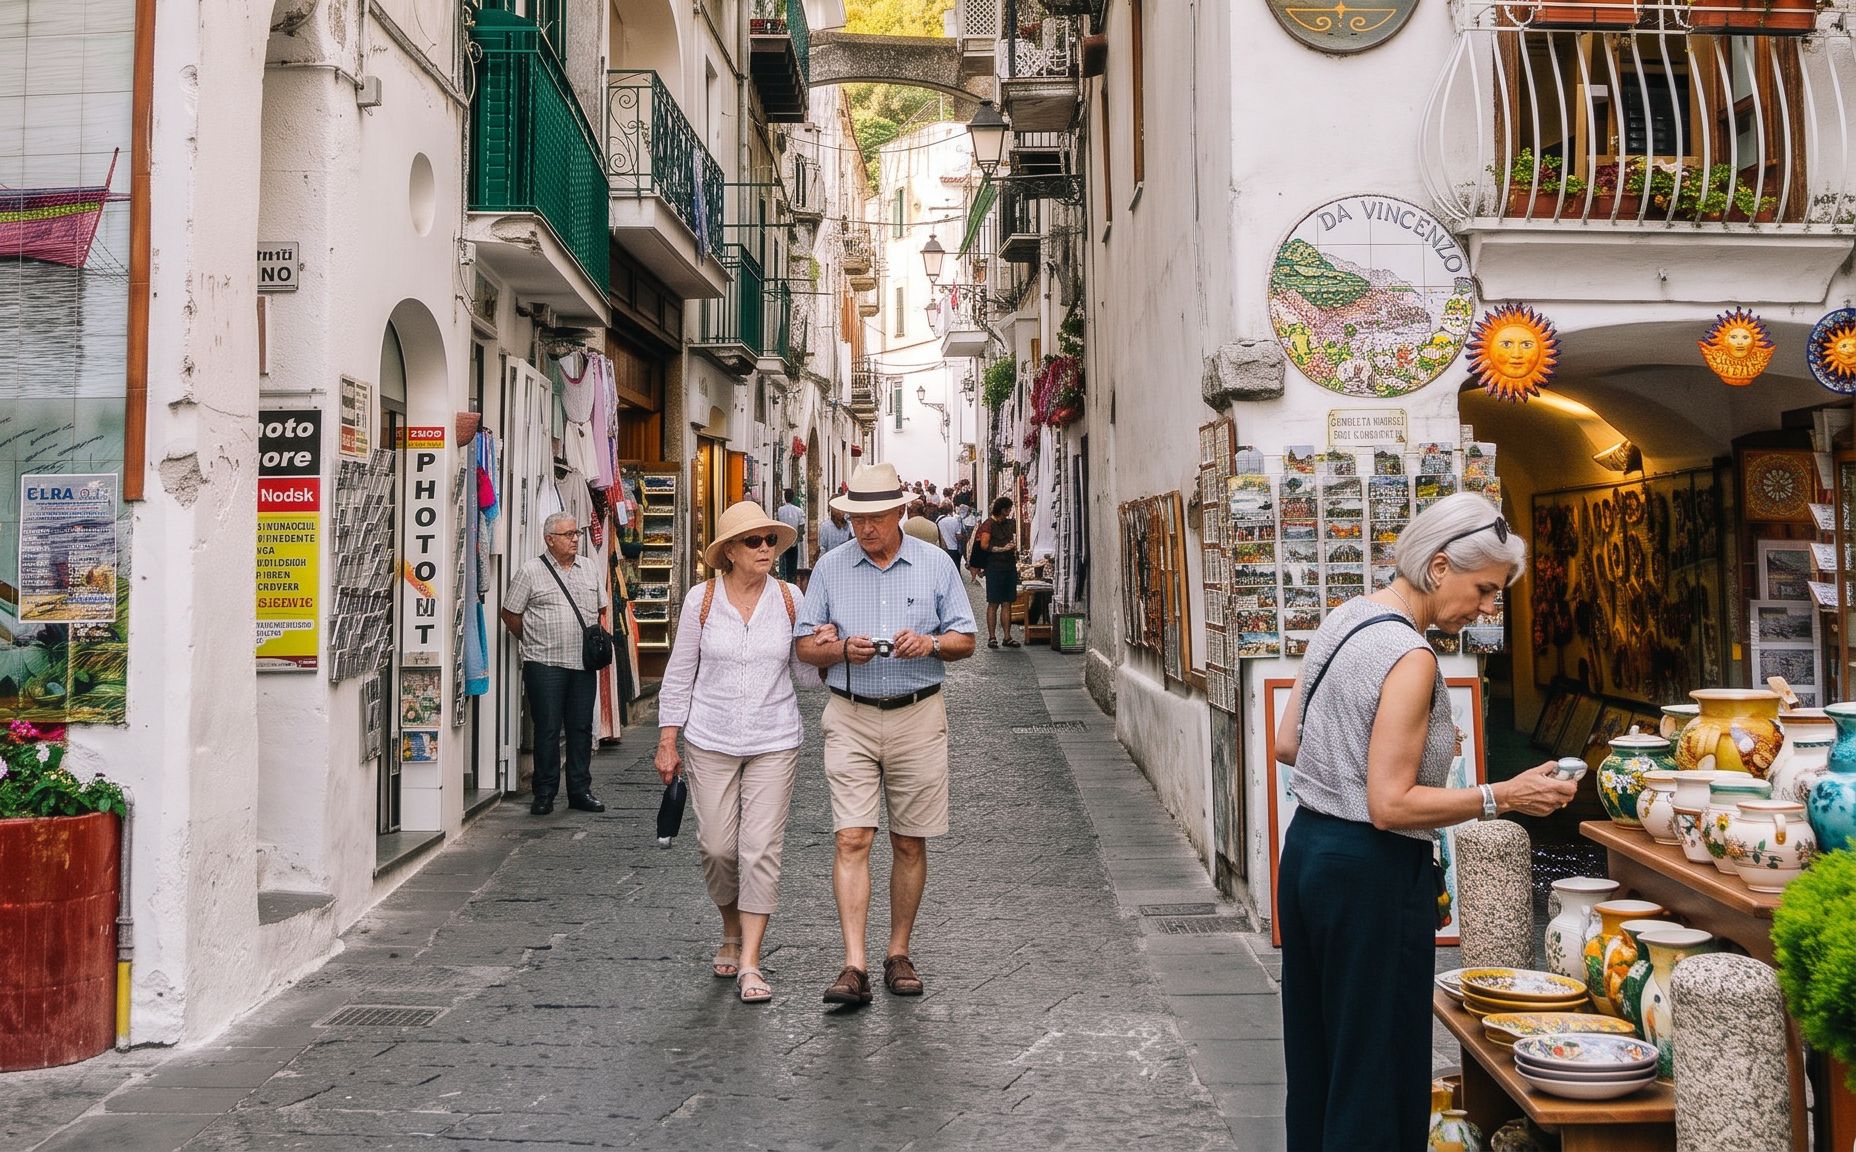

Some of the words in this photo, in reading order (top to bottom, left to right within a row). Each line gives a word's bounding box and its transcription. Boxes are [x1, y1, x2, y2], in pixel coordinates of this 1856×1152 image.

[1318, 203, 1353, 232] DA
[1360, 200, 1463, 273] VINCENZO
[261, 266, 292, 282] NO
[261, 488, 314, 503] Nodsk
